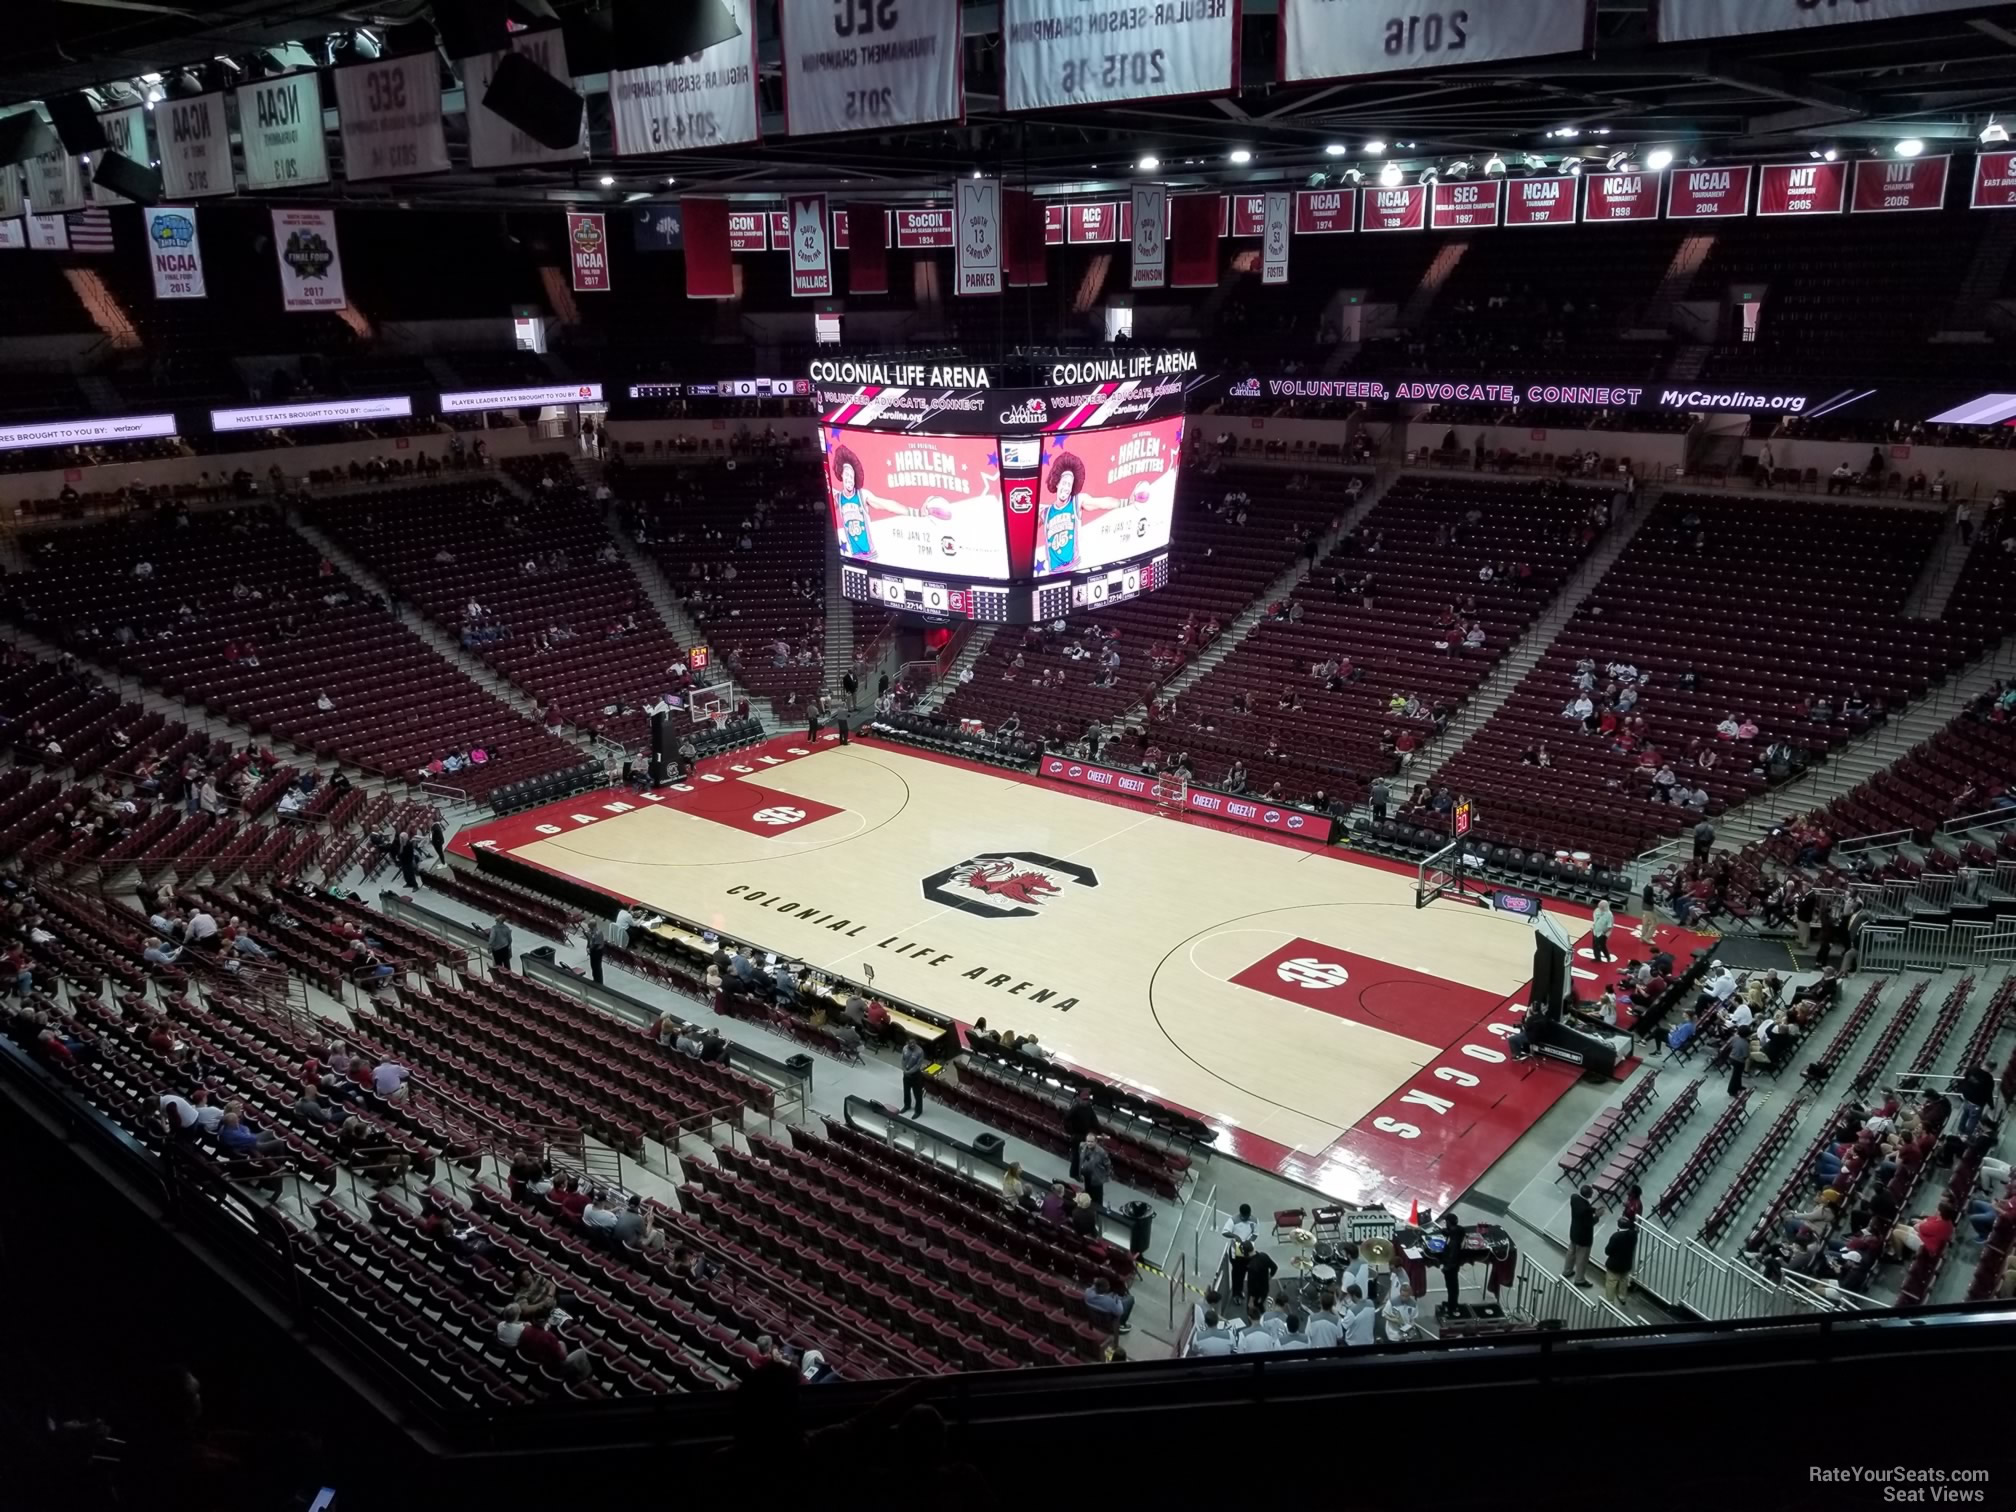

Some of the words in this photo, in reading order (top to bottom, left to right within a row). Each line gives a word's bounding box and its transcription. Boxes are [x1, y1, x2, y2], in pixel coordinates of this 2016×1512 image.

[1789, 167, 1816, 187] NIT
[1886, 163, 1915, 183] NIT
[1603, 177, 1641, 195] NCAA
[1689, 171, 1730, 190] NCAA
[1454, 186, 1478, 202] SEC
[1523, 182, 1559, 200] NCAA
[1310, 193, 1341, 210] NCAA
[1378, 191, 1409, 207] NCAA
[1788, 199, 1812, 210] 2005
[1884, 195, 1910, 207] 2006
[1083, 208, 1101, 223] ACC
[1611, 207, 1631, 217] 1998
[1696, 203, 1718, 214] 2004
[908, 213, 943, 227] SoCON
[970, 216, 988, 227] SOUTH
[1455, 214, 1473, 224] 1997
[1530, 211, 1550, 221] 1997
[800, 225, 817, 236] SOUTH
[1141, 219, 1155, 229] SOUTH
[1316, 221, 1333, 230] 1974
[804, 237, 814, 249] 42
[919, 236, 934, 244] 1934
[974, 229, 985, 244] 13
[1143, 230, 1152, 244] 14
[1273, 232, 1281, 243] 53
[798, 249, 821, 263] CAROLINA
[965, 244, 993, 260] CAROLINA
[156, 254, 198, 272] NCAA
[576, 253, 604, 268] NCAA
[1134, 269, 1163, 282] JOHNSON
[1266, 266, 1284, 278] FOSTER
[584, 277, 599, 285] 2017
[796, 276, 828, 289] WALLACE
[966, 273, 996, 288] PARKER
[170, 283, 192, 293] 2015
[304, 287, 324, 296] 2017
[810, 361, 891, 385] COLONIAL
[896, 365, 925, 387] LIFE
[930, 366, 990, 389] ARENA
[1053, 359, 1125, 386] COLONIAL
[1129, 354, 1151, 378] LIFE
[1155, 351, 1197, 375] ARENA
[741, 383, 750, 394] 0
[778, 382, 788, 394] 0
[1229, 386, 1261, 397] Carolina
[1269, 380, 1389, 400] VOLUNTEER,
[1395, 383, 1520, 405] ADVOCATE,
[1527, 386, 1642, 405] CONNECT
[475, 397, 499, 405] LEADER
[499, 395, 518, 403] STATS
[931, 399, 985, 411] CONNECT
[1661, 390, 1806, 412] MyCarolina.org
[236, 415, 264, 423] HUSTLE
[266, 413, 287, 421] STATS
[289, 411, 322, 419] BROUGHT
[1000, 411, 1047, 425] Carolina
[17, 431, 58, 442] BROUGHT
[74, 428, 93, 436] YOU
[113, 425, 142, 433] verizon
[1118, 438, 1161, 465] HARLEM
[895, 450, 956, 475] HARLEM
[1107, 458, 1165, 485] GLOBETROTTERS
[887, 472, 970, 495] GLOBETROTTERS
[908, 531, 921, 541] JAN
[922, 532, 931, 543] 12
[917, 545, 933, 556] 7PM
[889, 585, 898, 599] 0
[931, 592, 941, 606] 0
[906, 602, 923, 611] 27:14
[695, 655, 705, 667] 30
[535, 747, 810, 835] GAMECOCKS
[753, 806, 807, 826] SEC
[726, 885, 868, 938] COLONIAL
[877, 936, 954, 968] LIFE
[961, 966, 1081, 1012] ARENA
[1277, 957, 1349, 989] SEC
